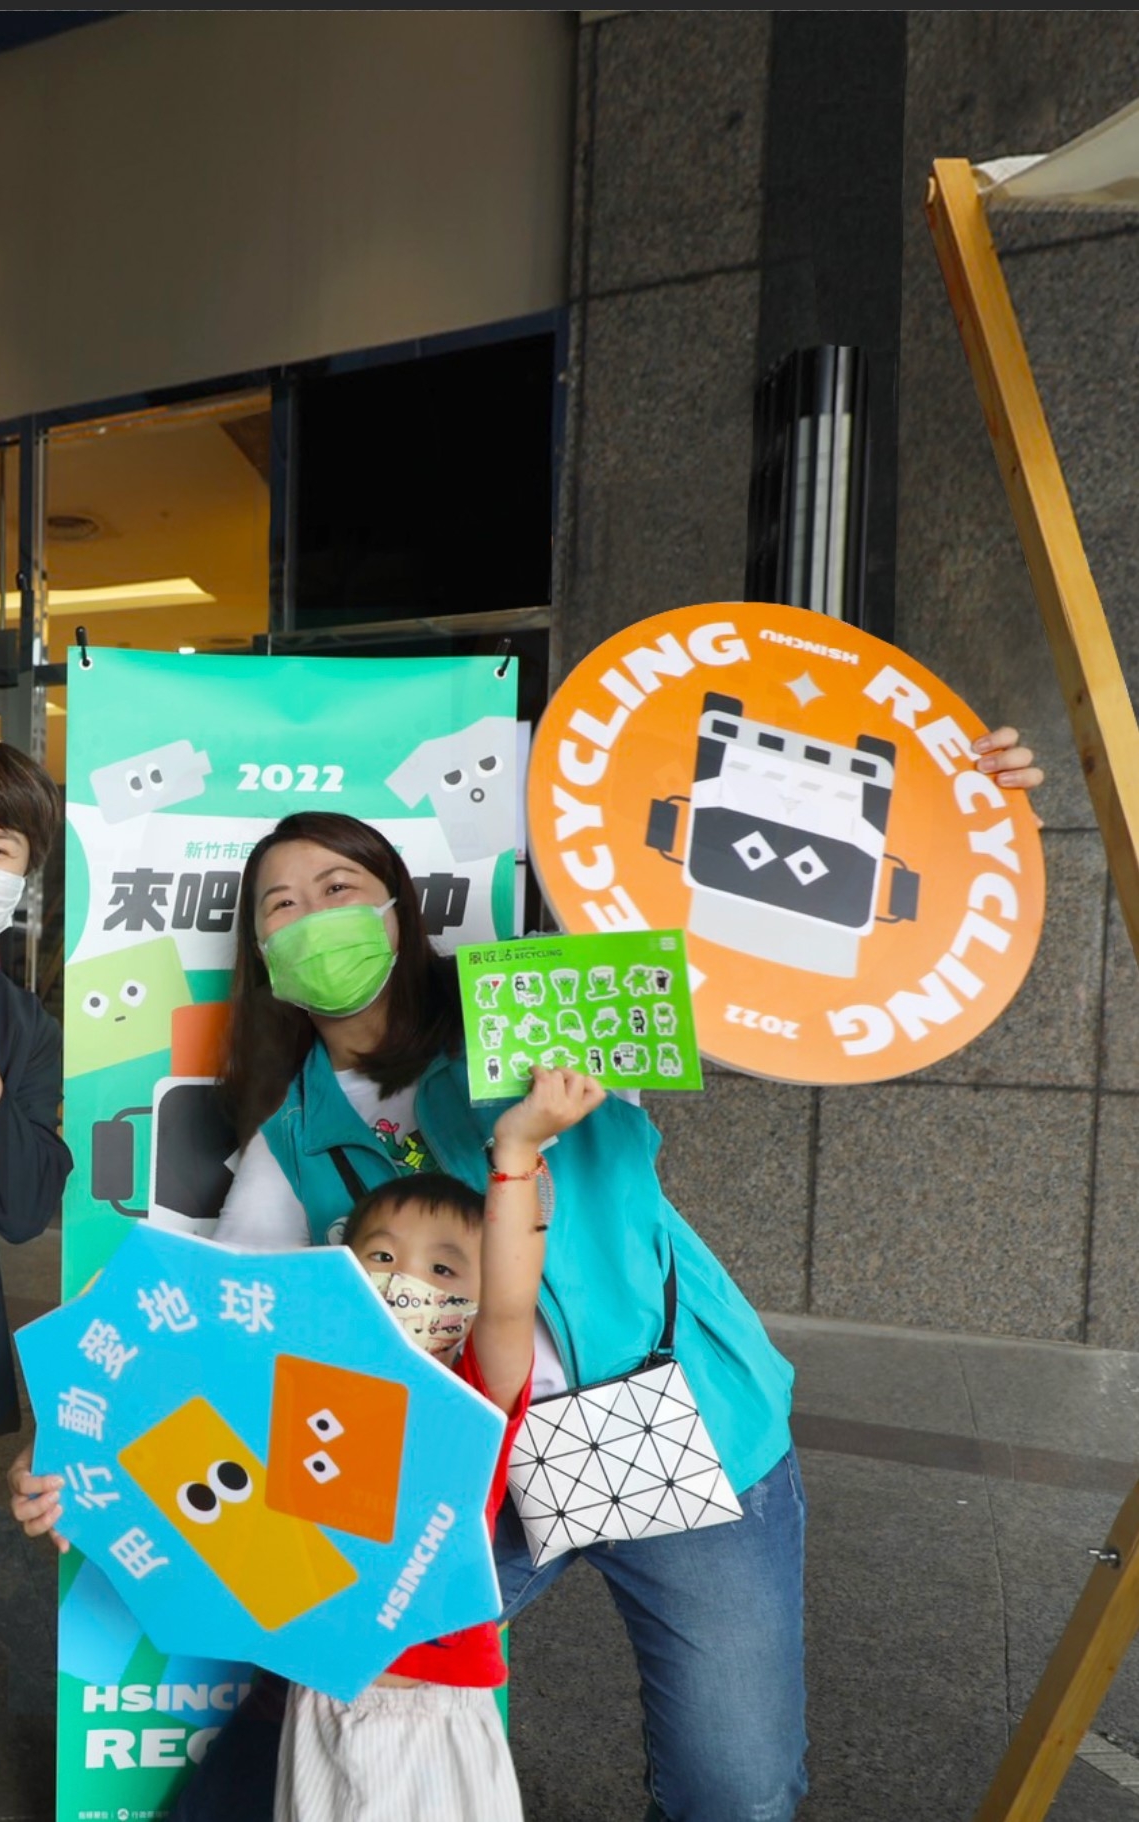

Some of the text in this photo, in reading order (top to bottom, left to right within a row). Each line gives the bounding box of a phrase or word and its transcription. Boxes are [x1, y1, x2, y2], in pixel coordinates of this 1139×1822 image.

[759, 628, 860, 666] HSINCHU
[236, 763, 344, 793] 2022
[553, 622, 752, 993] ECYCLING
[827, 666, 1021, 1056] RECYCLING
[724, 1004, 802, 1040] 2022
[57, 1279, 276, 1580] 用行動愛地球
[375, 1503, 457, 1631] HSINCHU
